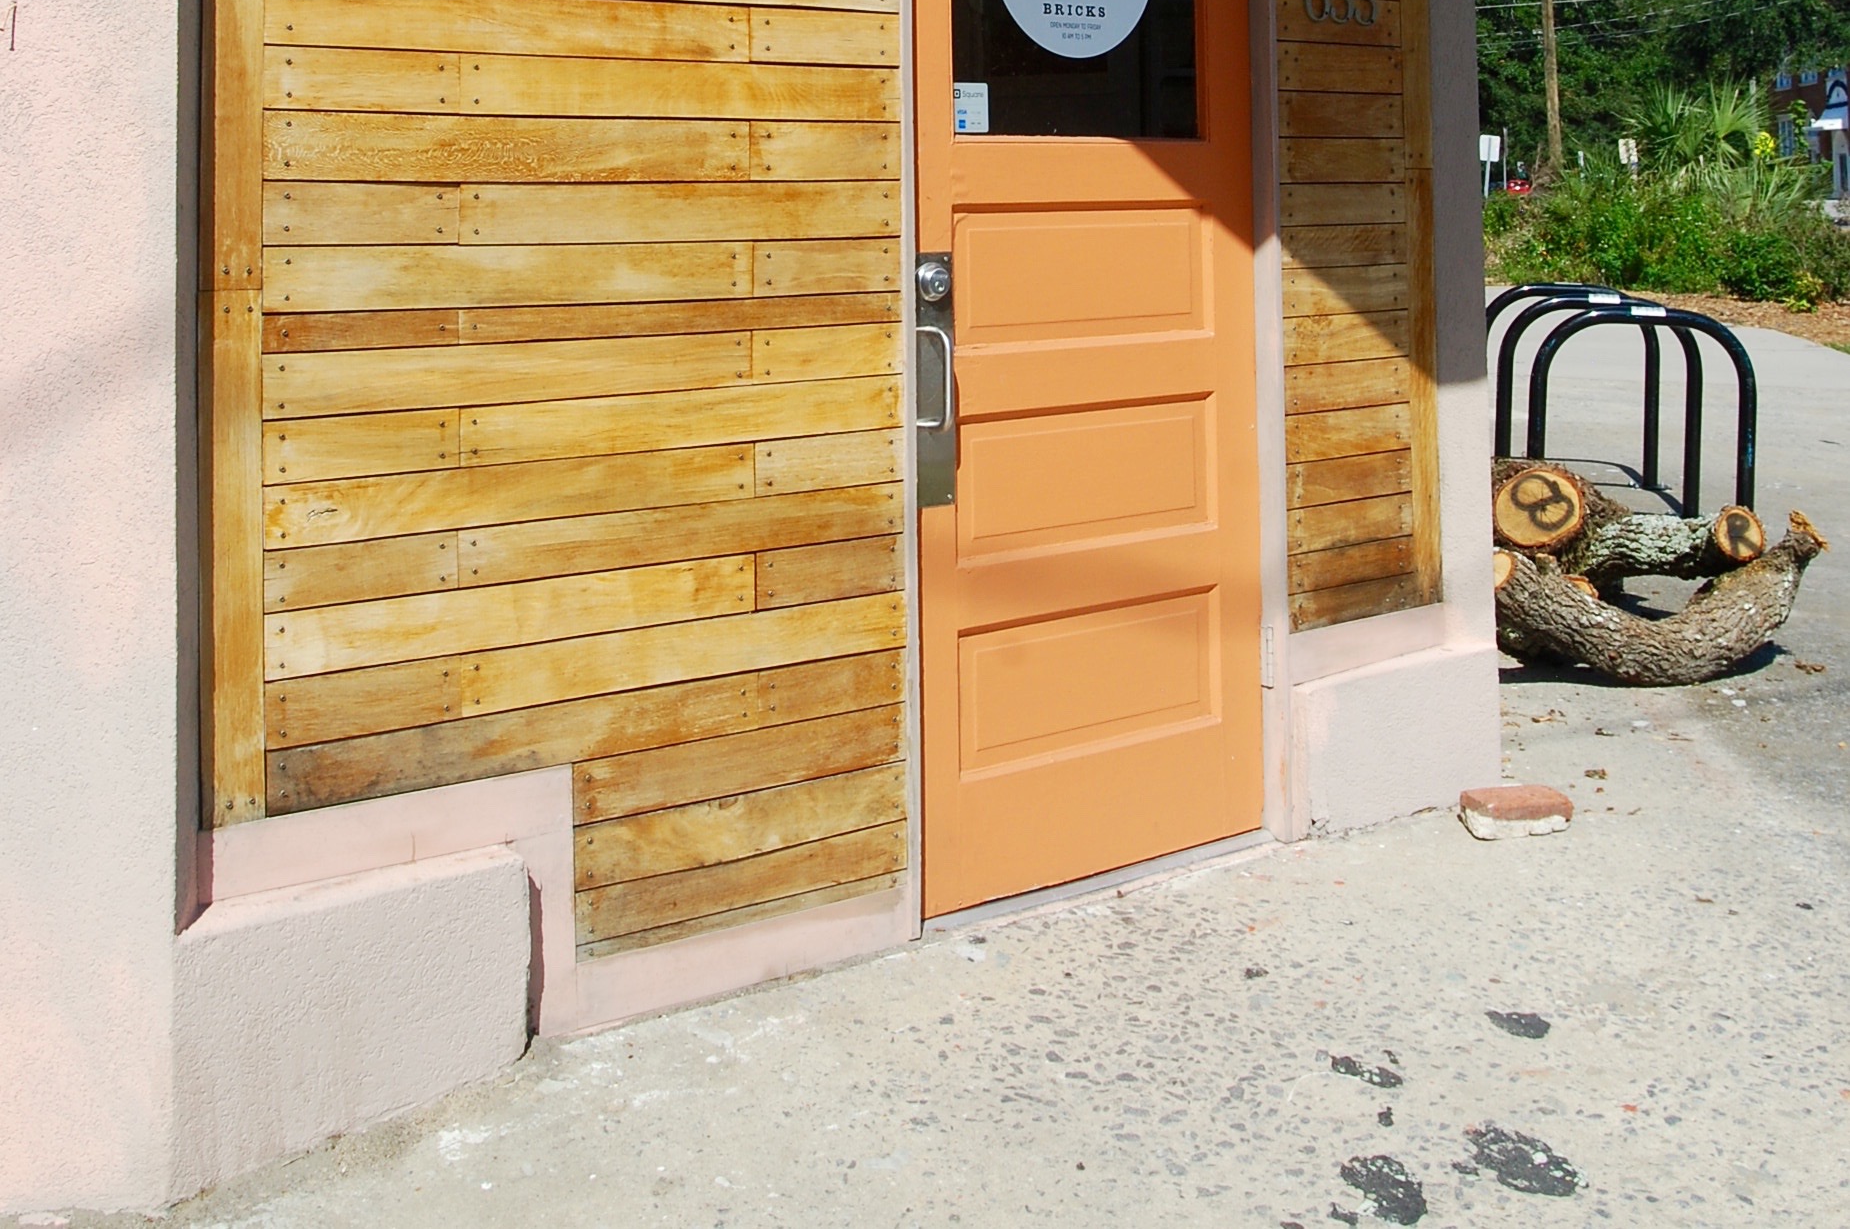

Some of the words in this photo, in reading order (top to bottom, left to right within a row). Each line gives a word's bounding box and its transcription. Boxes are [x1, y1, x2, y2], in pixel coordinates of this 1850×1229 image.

[1043, 3, 1106, 18] BRICKS
[1050, 21, 1062, 29] OPEN
[962, 90, 984, 99] Square
